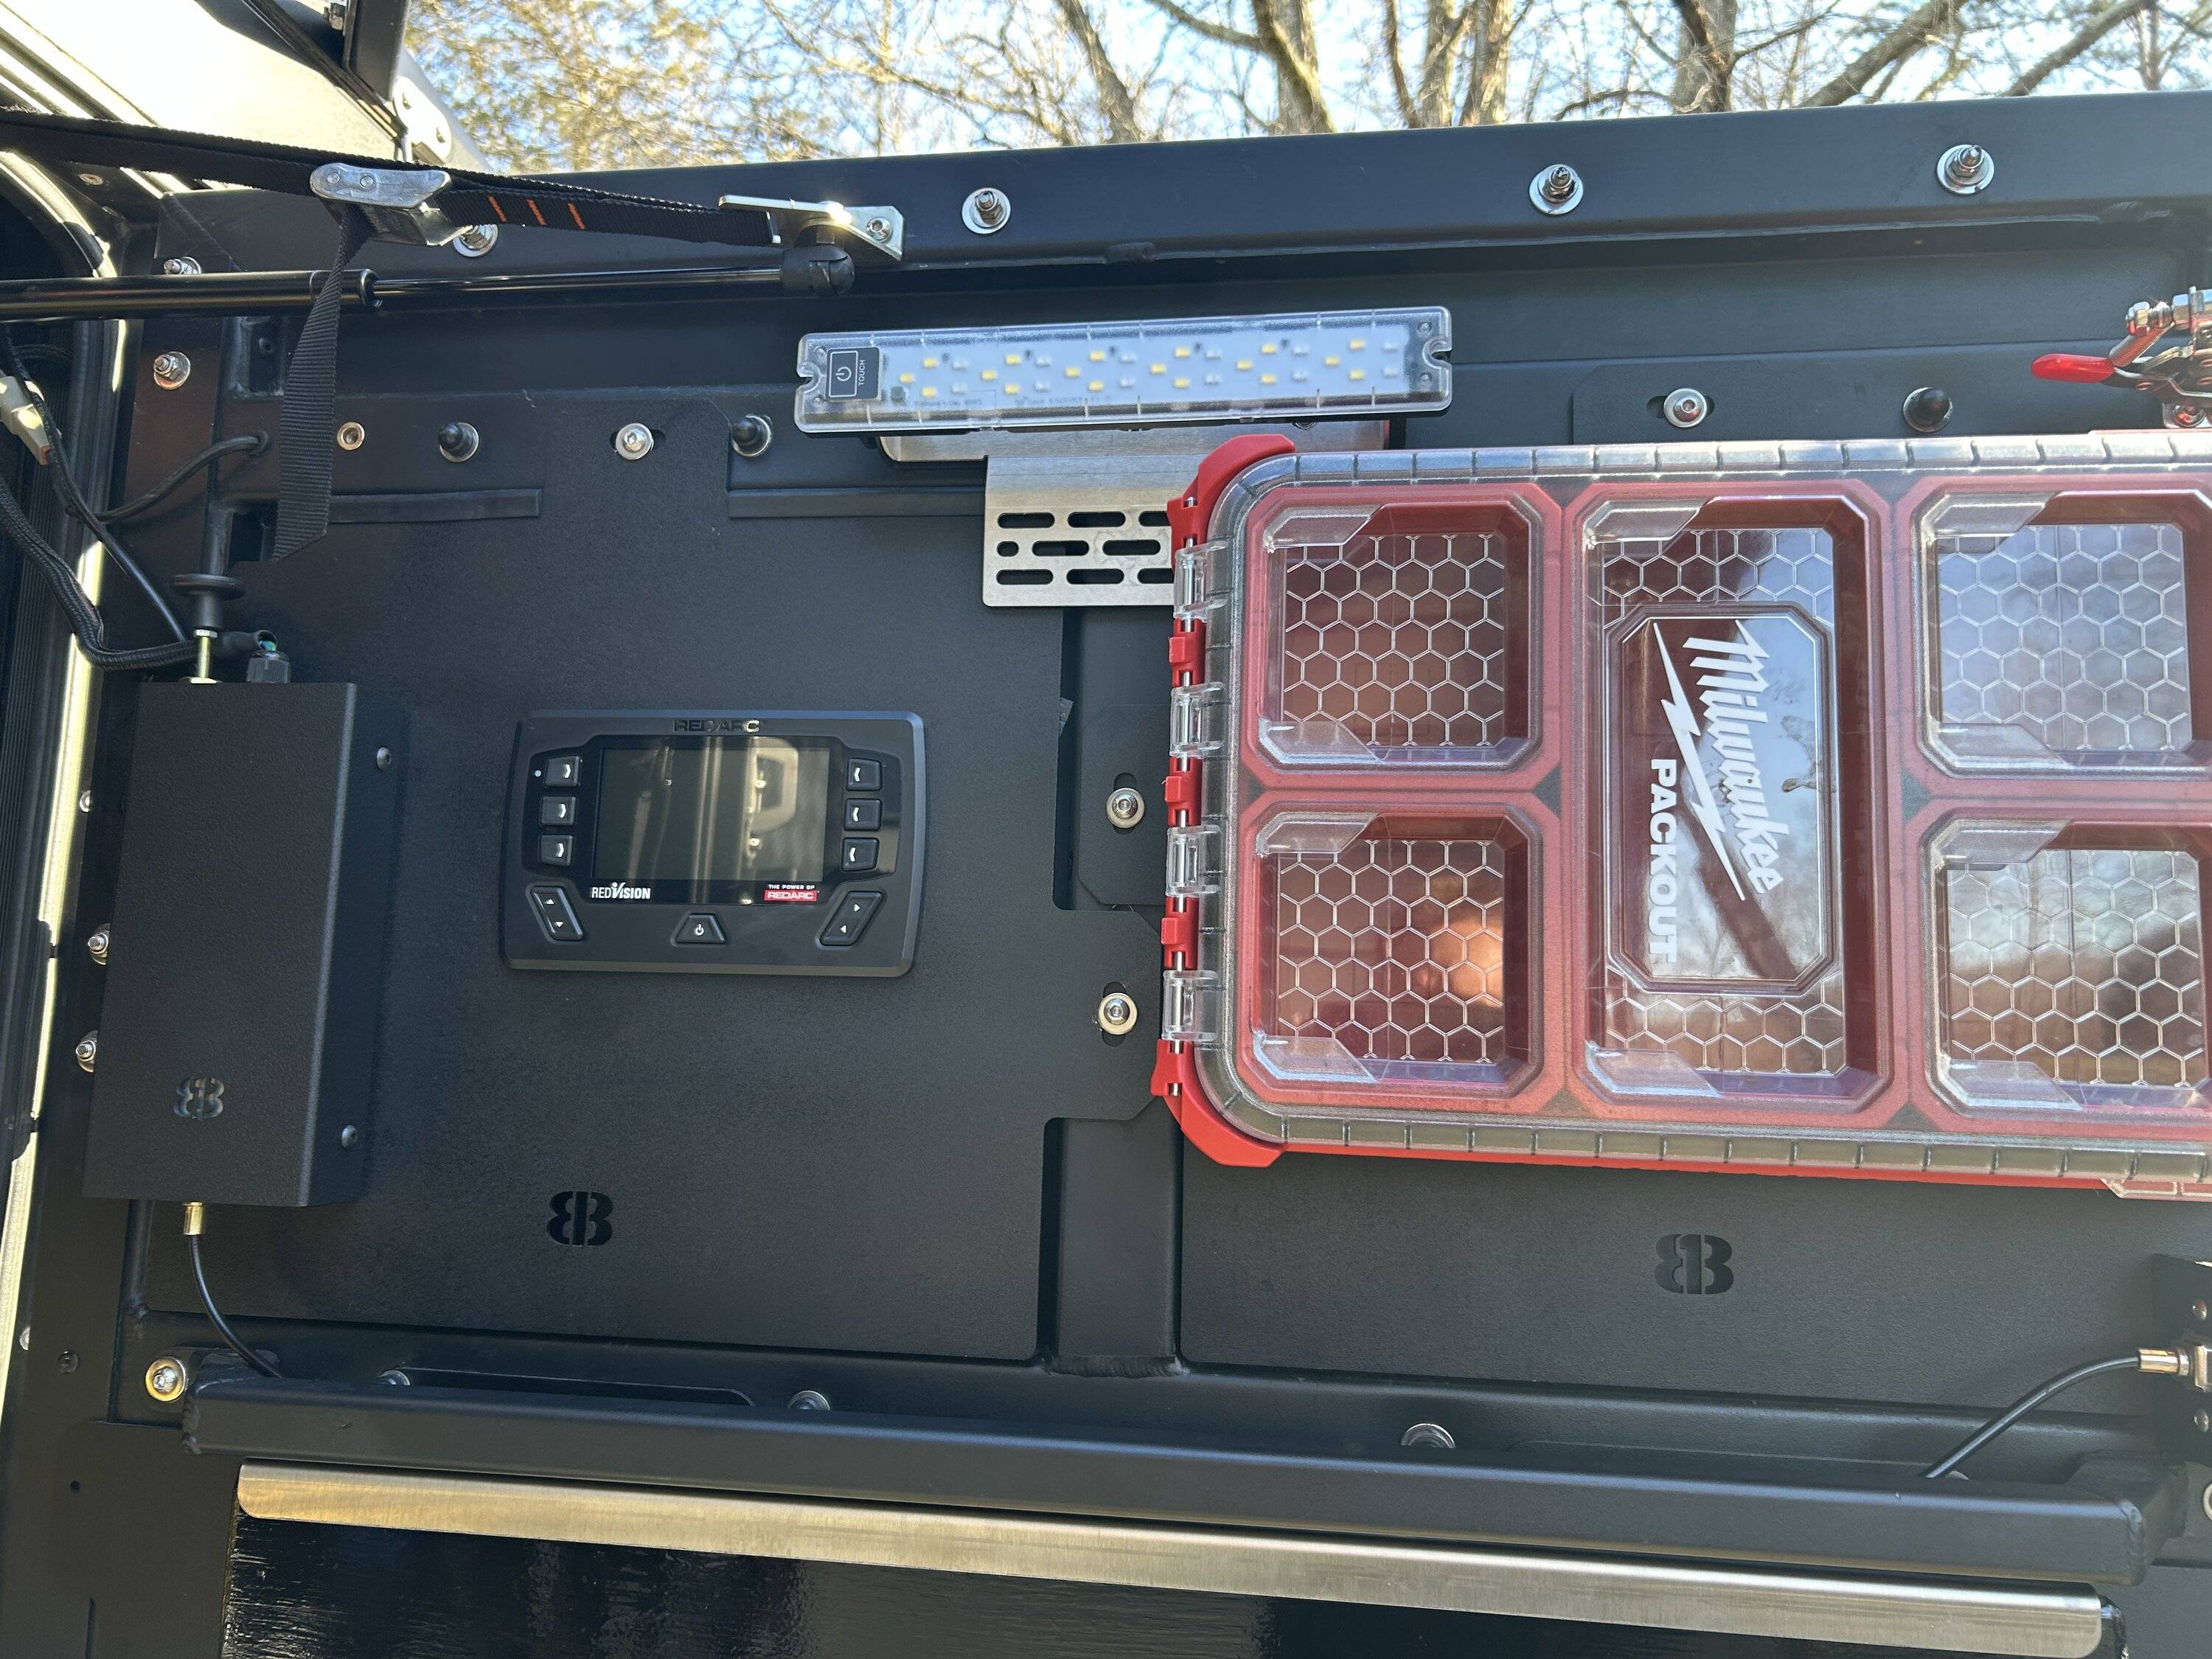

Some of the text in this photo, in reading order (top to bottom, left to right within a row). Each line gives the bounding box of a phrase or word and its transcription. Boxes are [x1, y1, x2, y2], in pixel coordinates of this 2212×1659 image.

[673, 719, 760, 733] REDARC
[1682, 619, 1790, 894] Milwaukee
[768, 891, 815, 900] REDARC
[1649, 759, 1677, 963] PACKOUT
